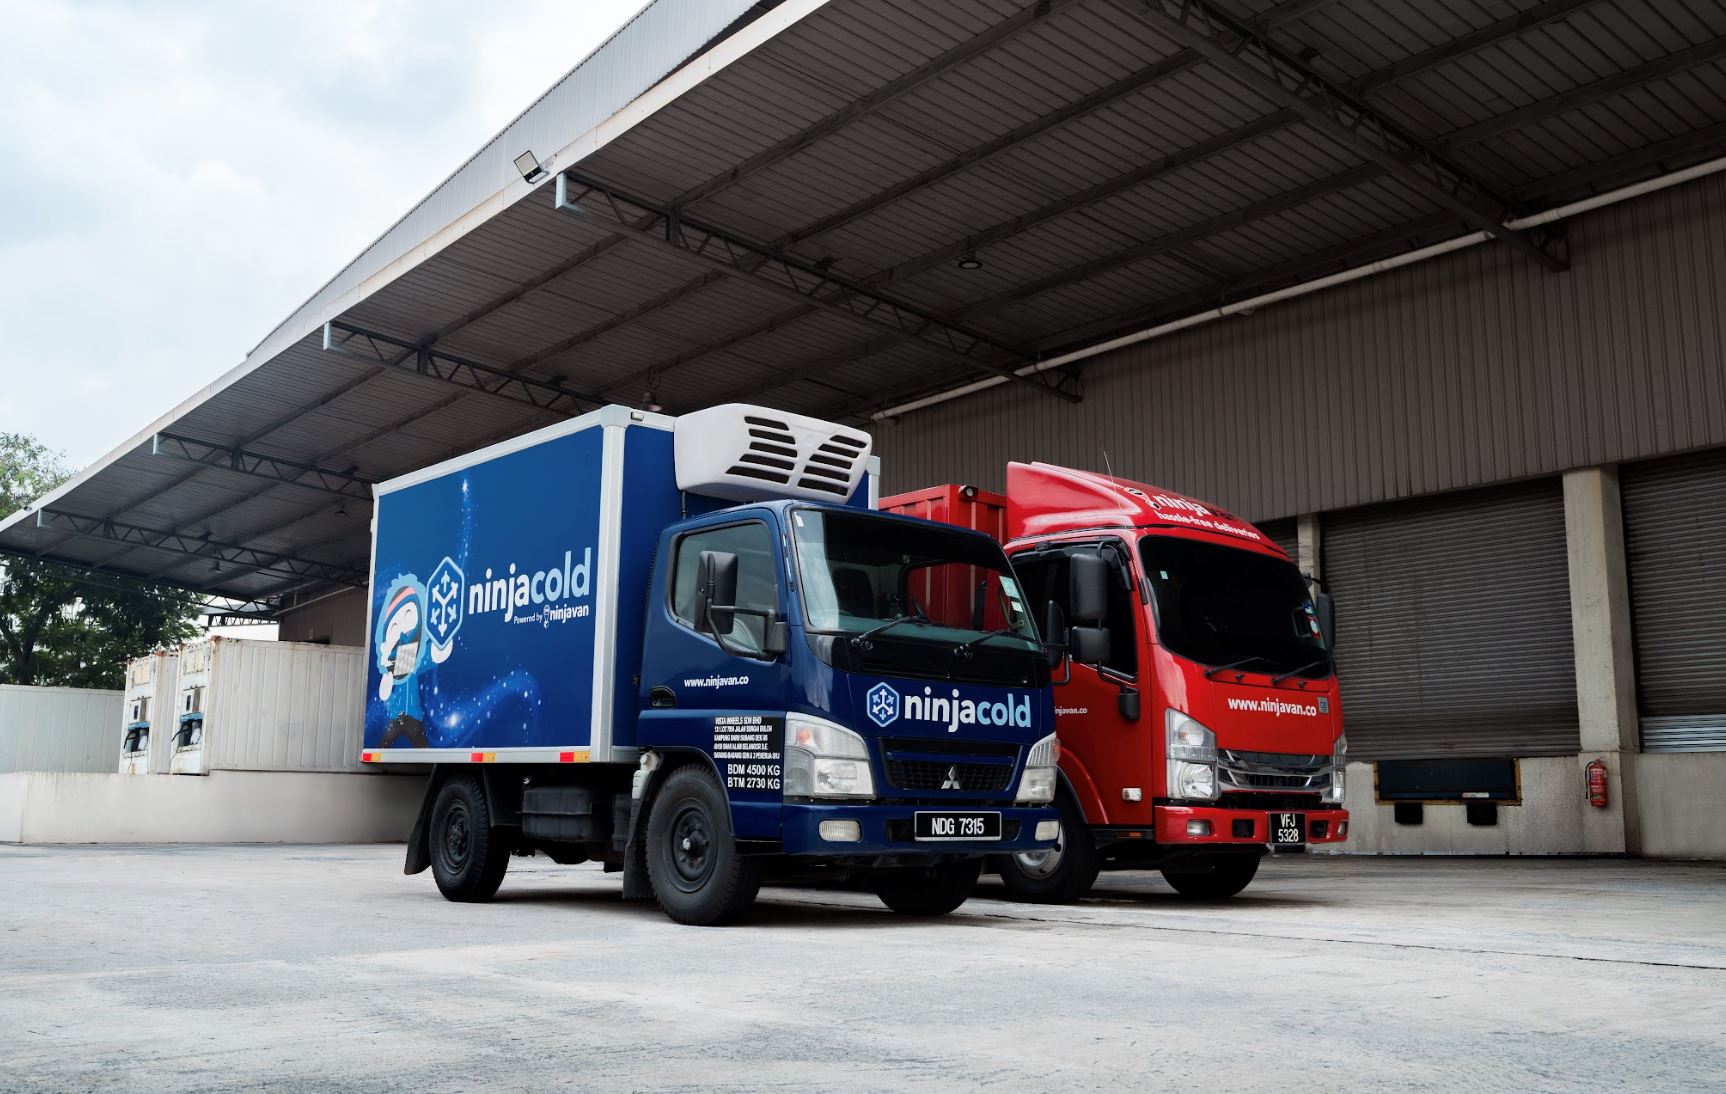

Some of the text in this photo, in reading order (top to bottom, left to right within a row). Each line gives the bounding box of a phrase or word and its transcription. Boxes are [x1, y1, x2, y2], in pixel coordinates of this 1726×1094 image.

[1154, 510, 1260, 540] hassle-free deliveries
[469, 547, 592, 623] ninjacold
[513, 613, 543, 625] Powered by
[550, 603, 589, 624] ninjavan
[684, 674, 749, 689] www.ninjavan.co
[904, 686, 1032, 733] ninjacold
[1227, 697, 1317, 717] www.ninjavan.co
[728, 763, 781, 777] BDM 4500 KG
[728, 777, 781, 790] BTM 2730 KG
[931, 818, 985, 835] NDG 7315
[1280, 813, 1296, 828] VFJ
[1278, 828, 1299, 842] 5328
